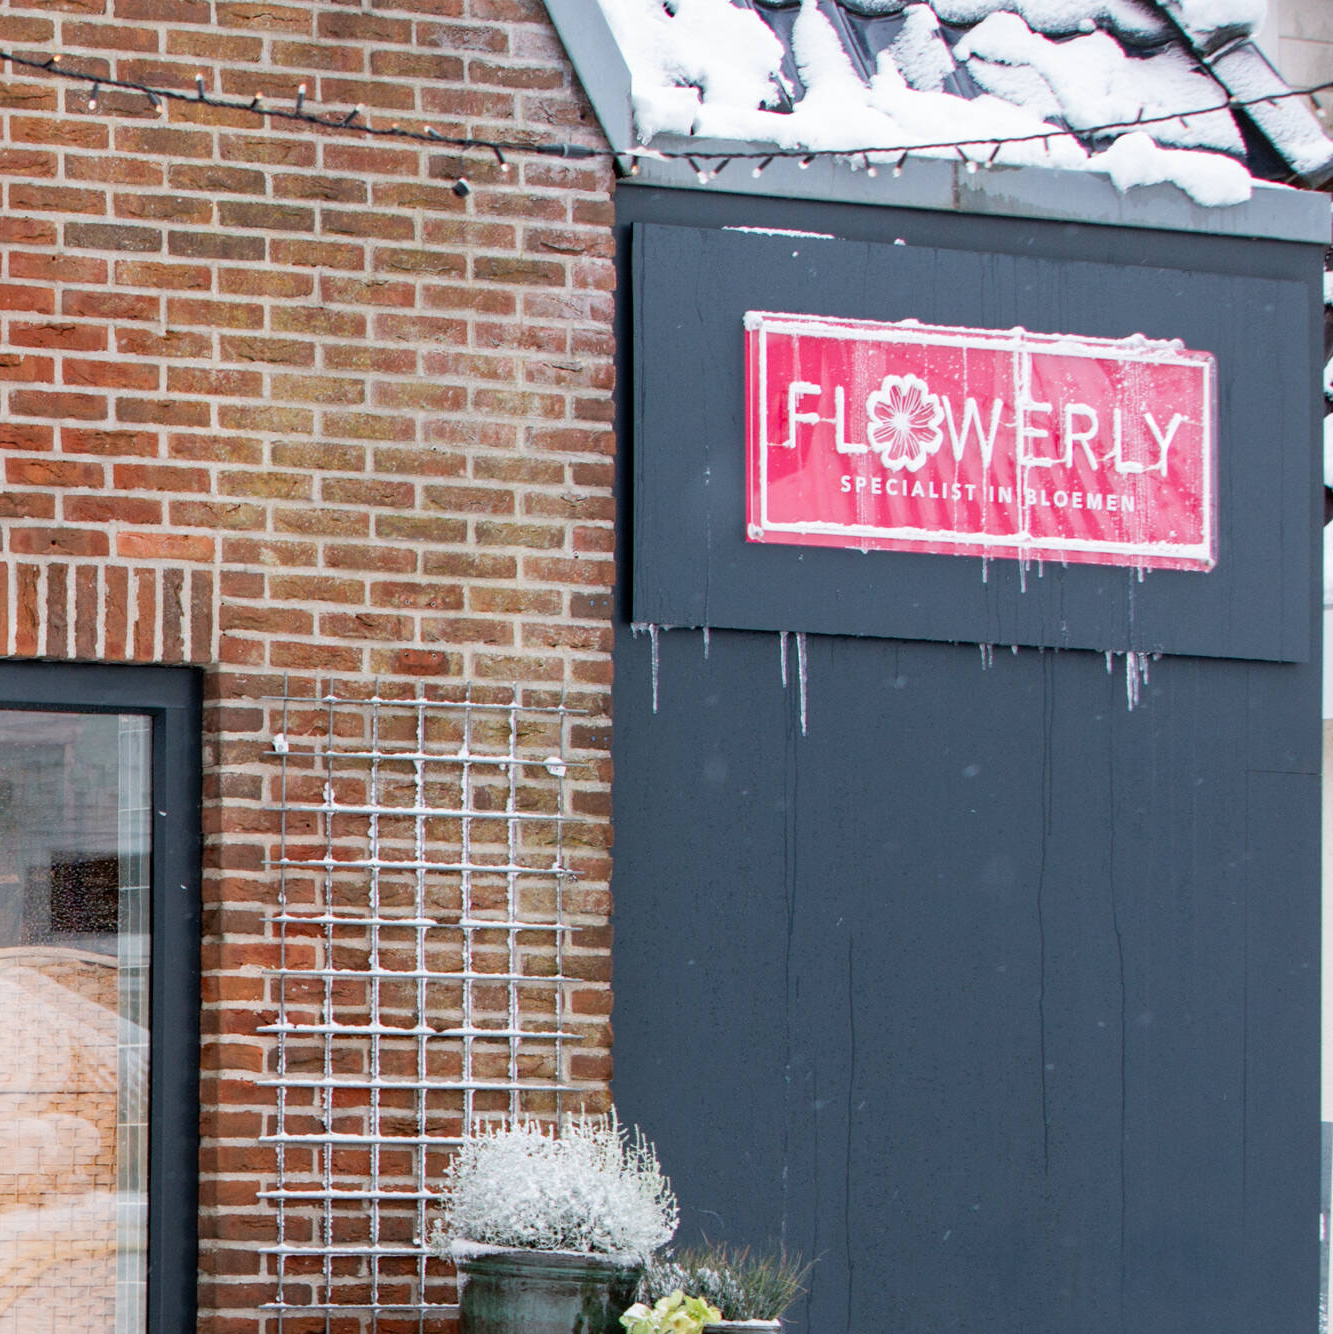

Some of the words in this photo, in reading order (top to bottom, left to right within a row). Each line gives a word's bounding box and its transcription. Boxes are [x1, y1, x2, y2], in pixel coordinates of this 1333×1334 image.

[840, 475, 976, 502] SPECIALIST
[989, 486, 1013, 504] IN
[1025, 491, 1136, 513] BLOEMEN
